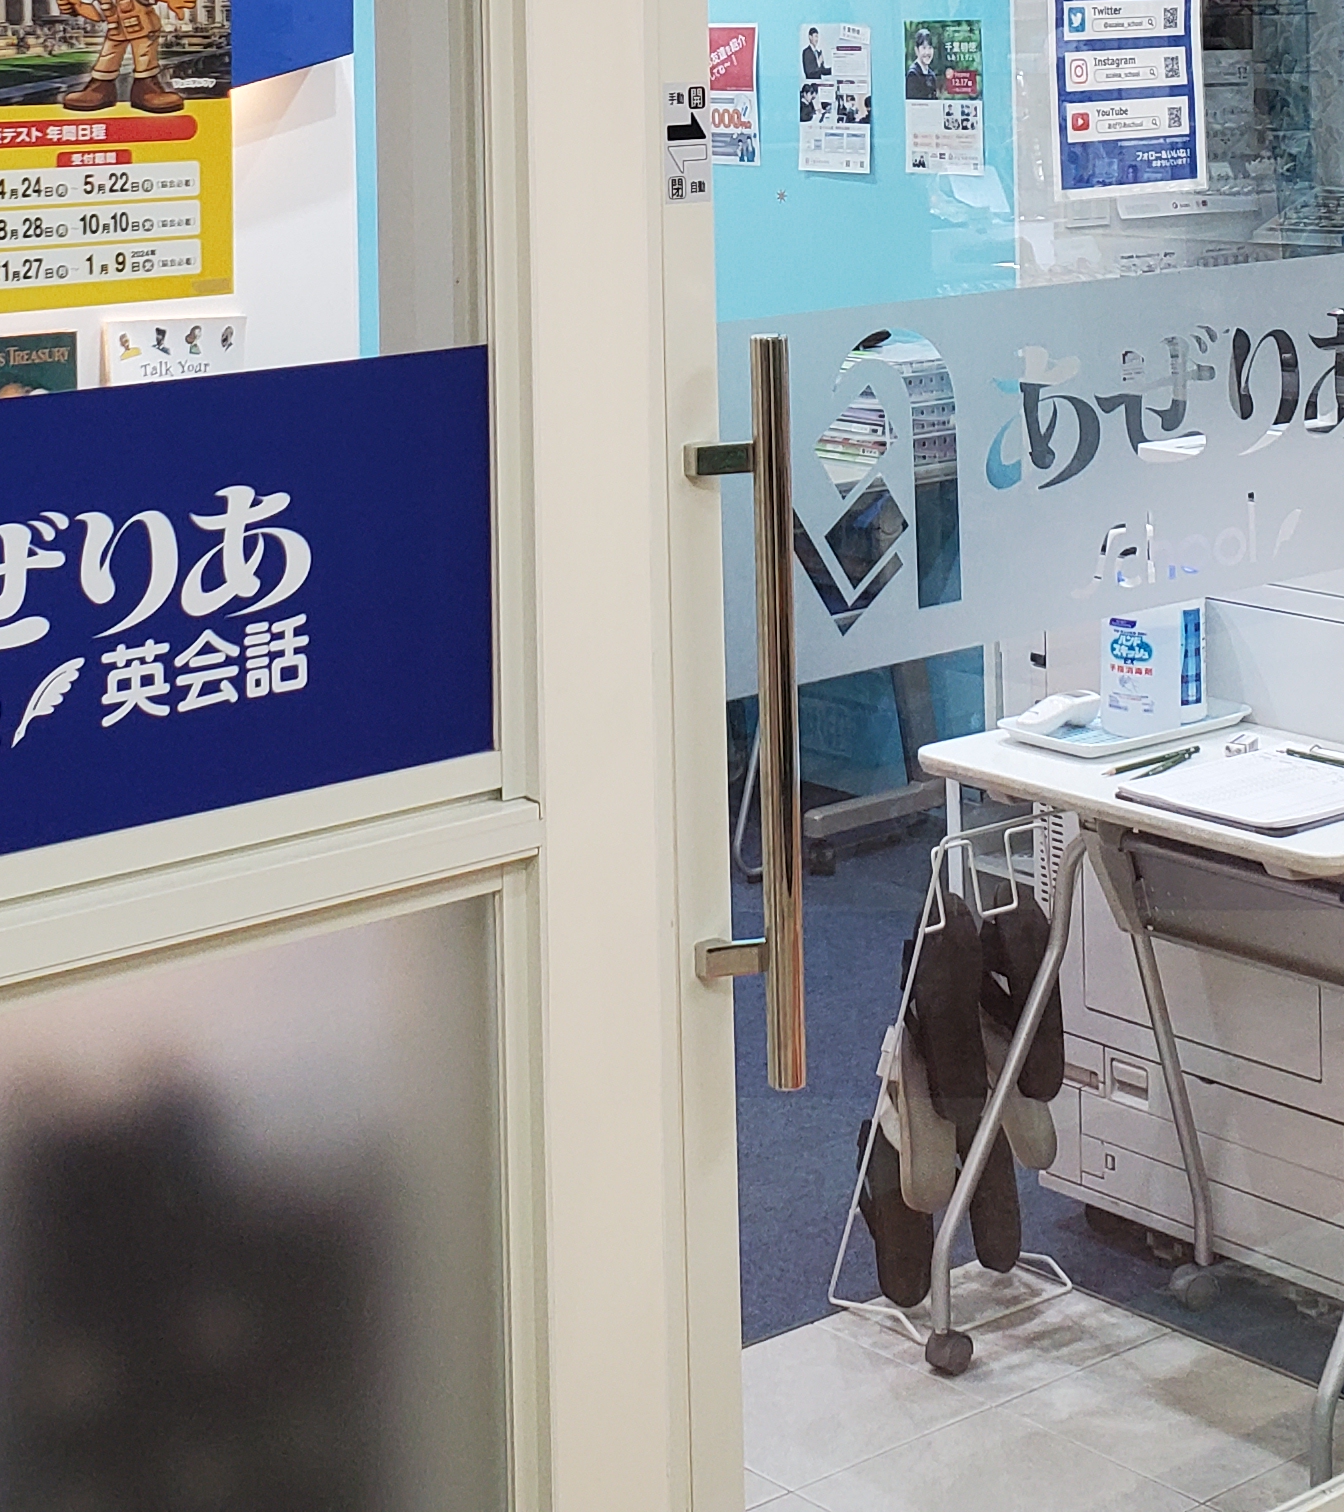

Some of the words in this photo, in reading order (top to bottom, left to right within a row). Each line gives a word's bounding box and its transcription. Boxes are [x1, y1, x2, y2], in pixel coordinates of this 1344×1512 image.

[1092, 6, 1122, 16] Twitter
[1093, 57, 1136, 68] Instagram
[668, 92, 684, 105] 手動
[690, 87, 703, 108] 開
[1096, 107, 1128, 118] YouTube
[46, 124, 107, 142] 年間日程
[670, 178, 684, 199] 閉
[690, 181, 706, 194] 自動
[140, 363, 174, 379] Talk
[178, 359, 210, 375] Your
[100, 621, 312, 728] 英会話
